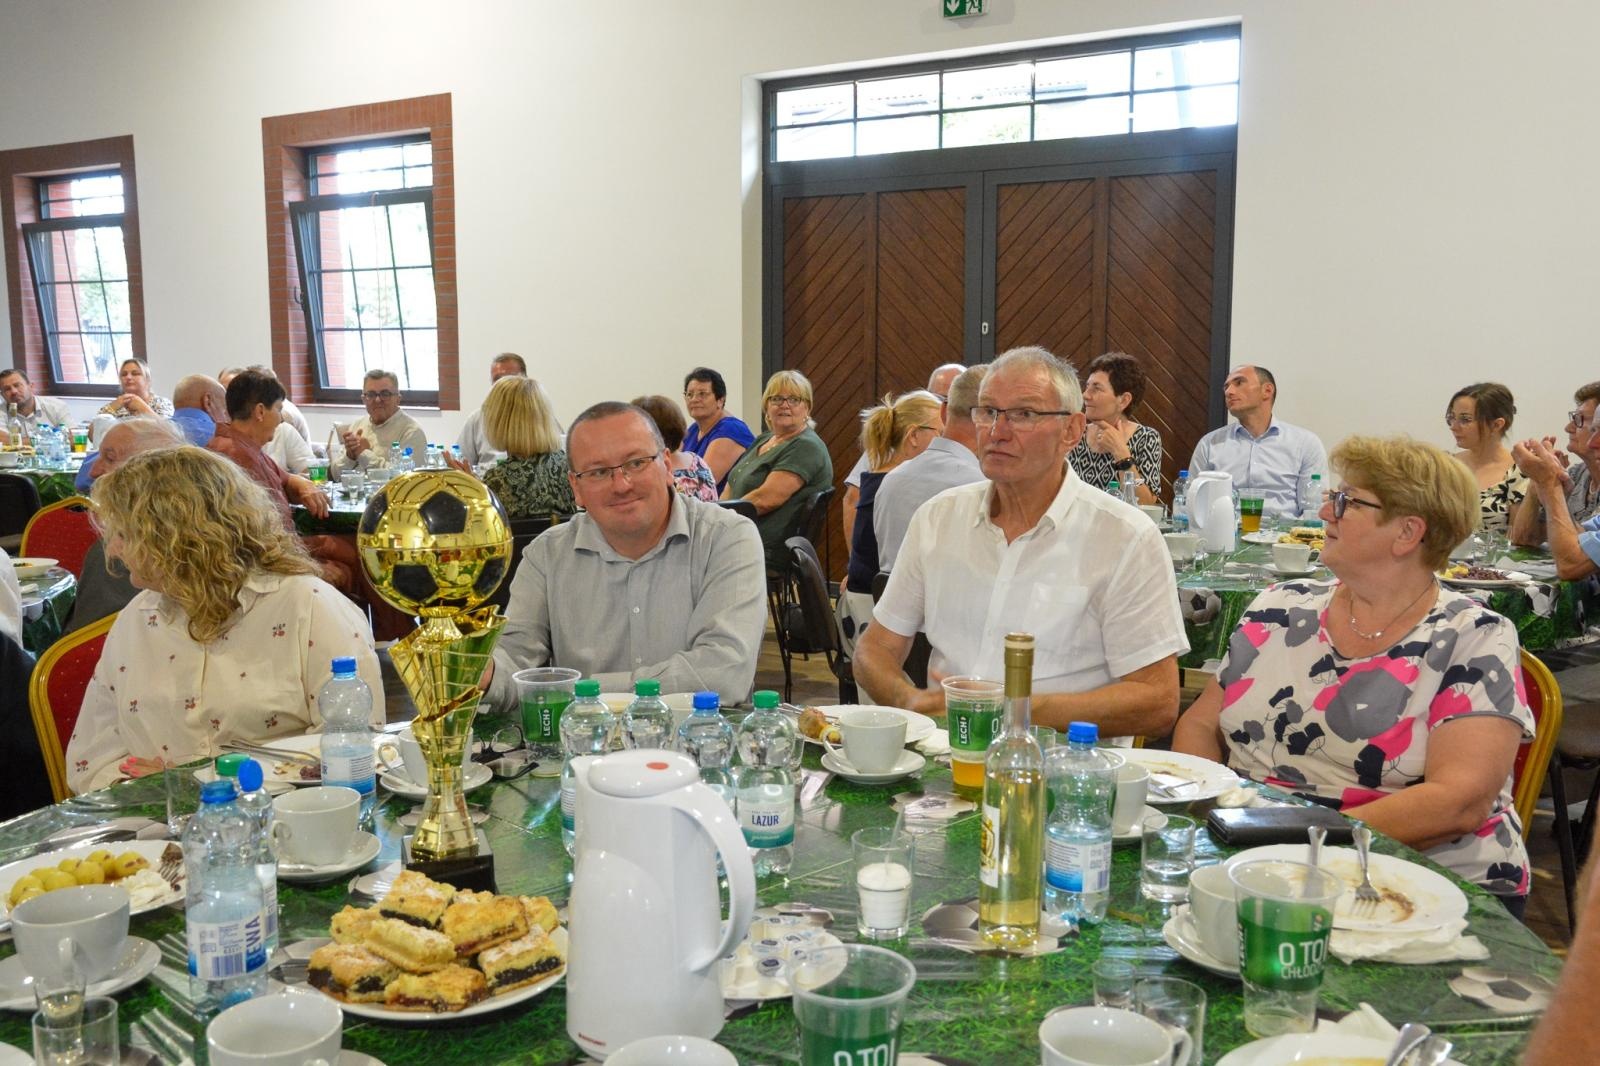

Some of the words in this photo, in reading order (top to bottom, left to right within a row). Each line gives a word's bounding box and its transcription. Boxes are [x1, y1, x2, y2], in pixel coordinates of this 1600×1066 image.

[542, 713, 551, 737] LECH
[959, 720, 968, 744] LECH
[751, 814, 779, 827] LAZUR
[1279, 942, 1296, 967] O
